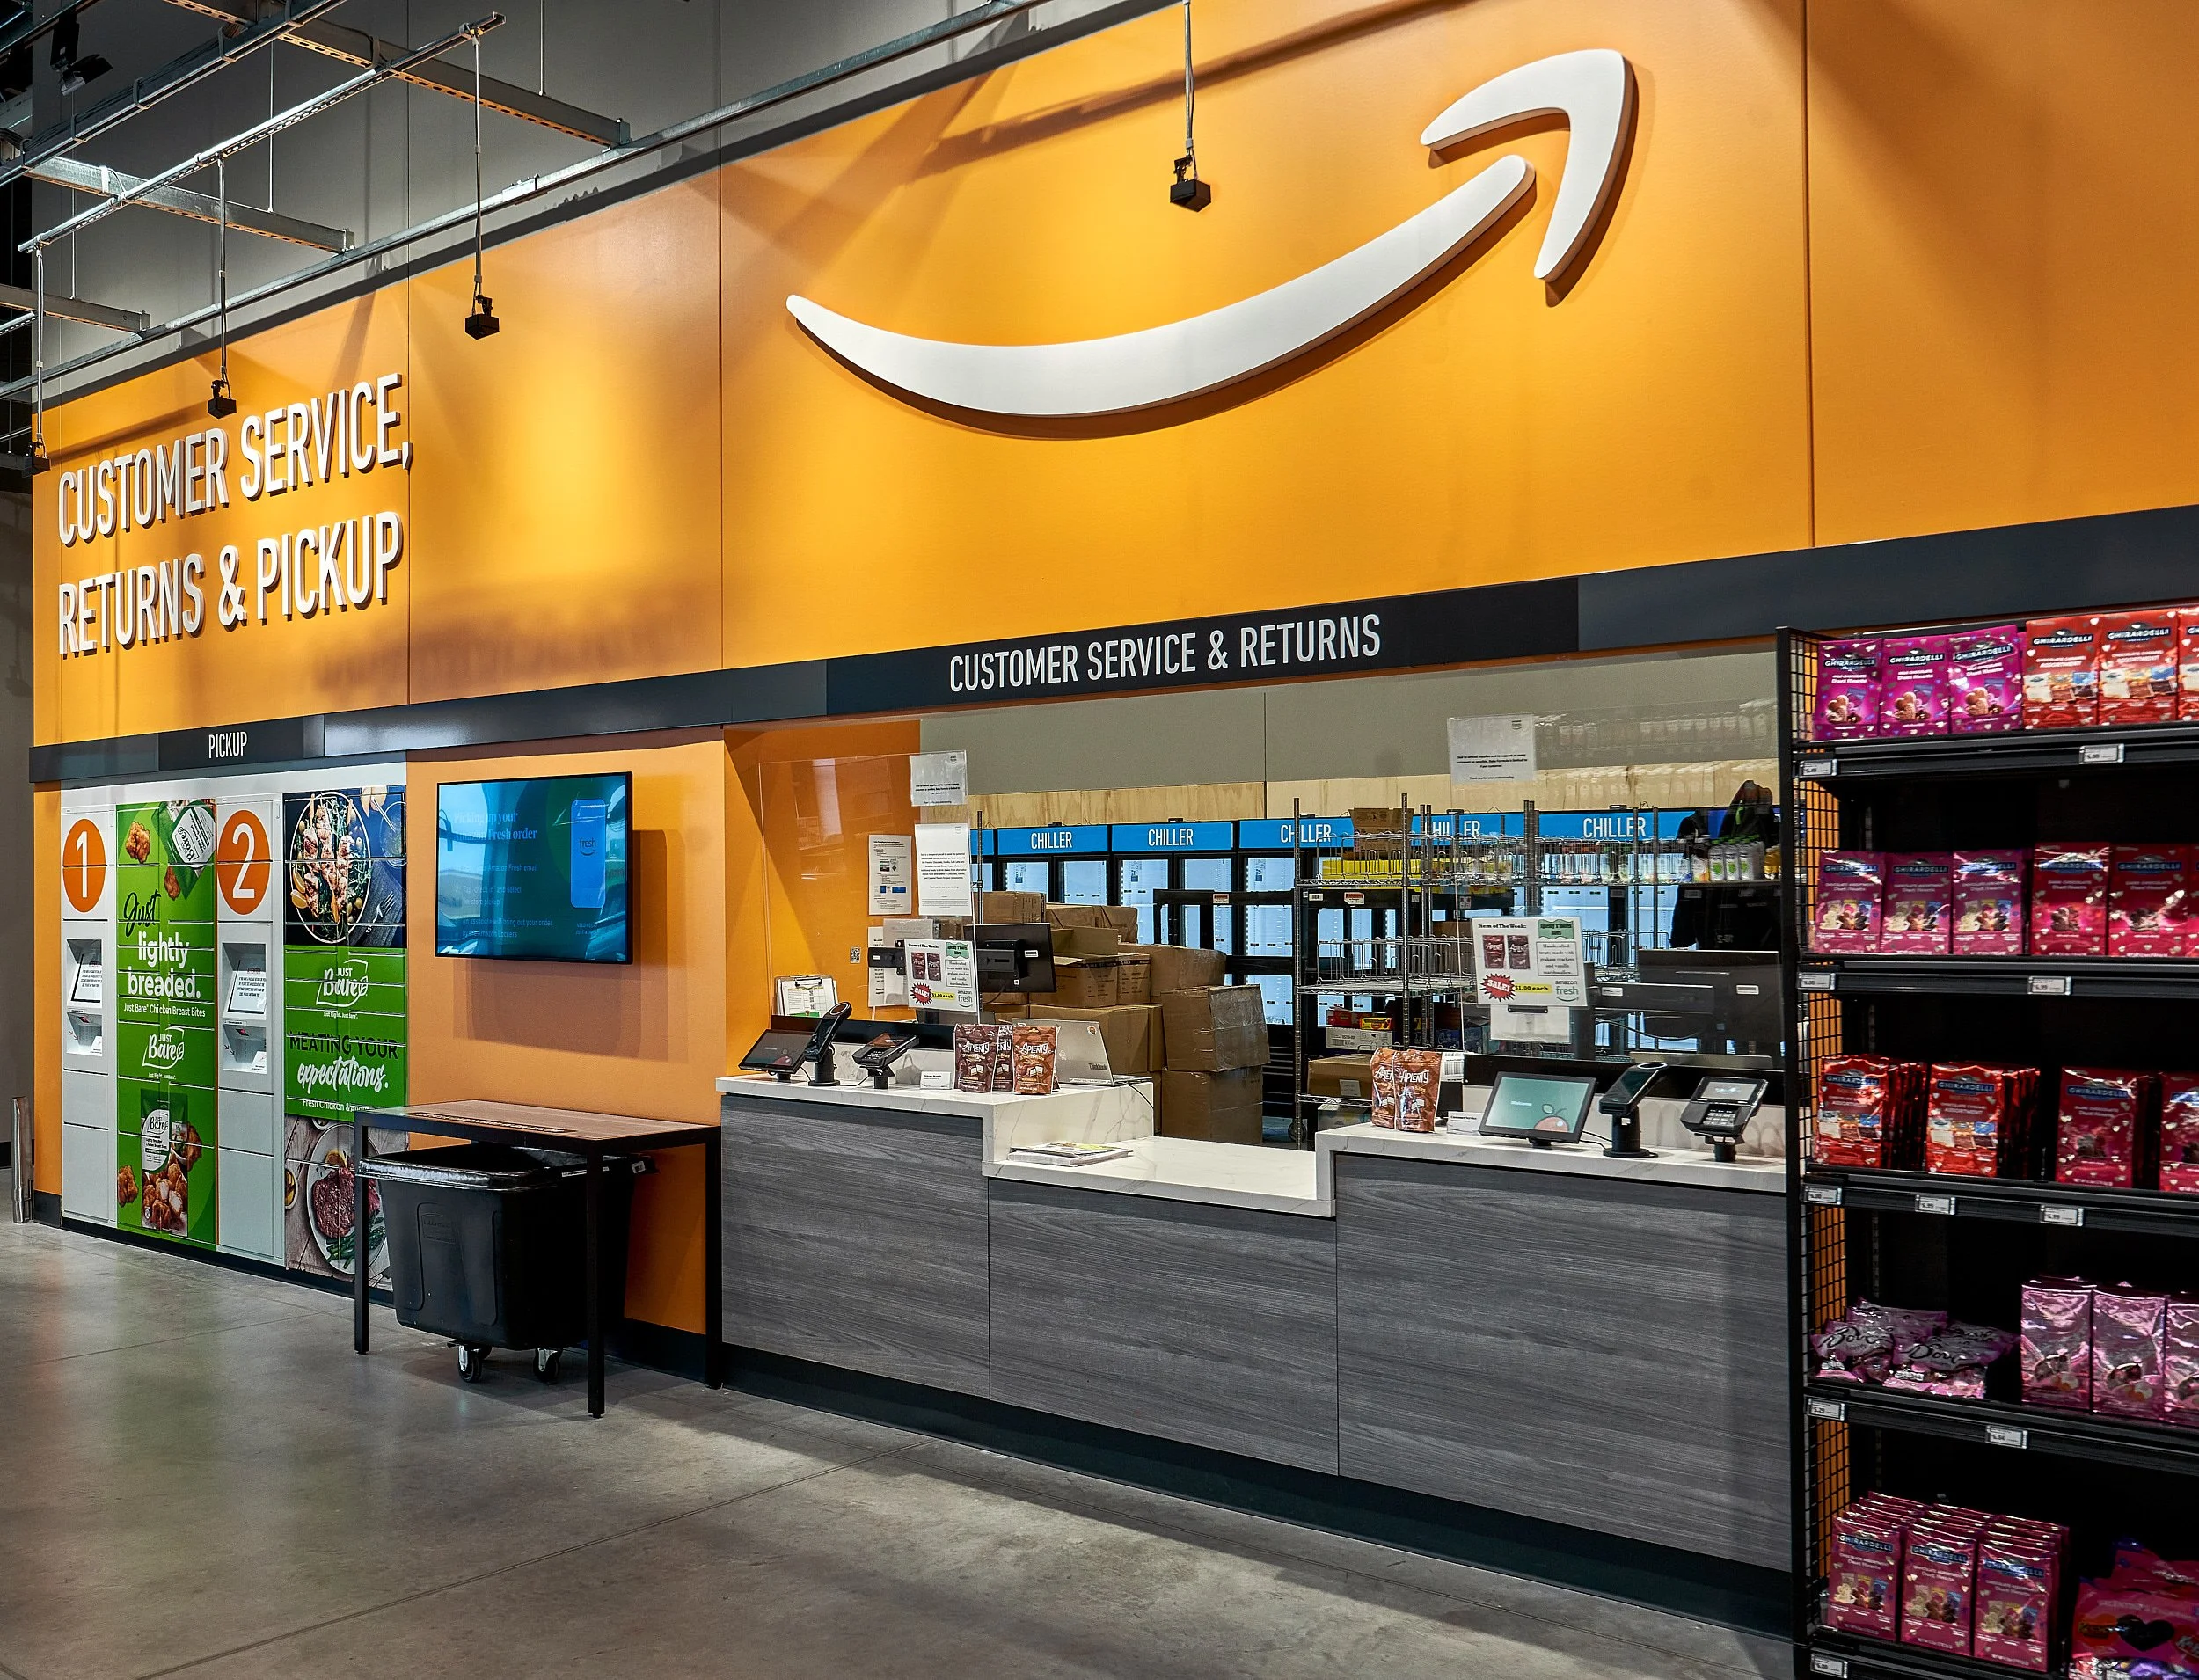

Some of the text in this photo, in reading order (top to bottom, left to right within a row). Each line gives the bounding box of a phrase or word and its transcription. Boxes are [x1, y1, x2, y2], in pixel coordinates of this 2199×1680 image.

[58, 373, 413, 546] CUSTOMER SERVICE,
[59, 511, 404, 659] RETURNS & PICKUP
[2033, 635, 2093, 645] GHIRARDELLI
[2108, 628, 2169, 639] GHIRARDELLI
[950, 613, 1381, 692] CUSTOMER SERVICE & RETURNS
[1890, 654, 1943, 663] GHIRARDELLI
[1955, 646, 2012, 659] GHIRARDELLI
[1825, 658, 1875, 668] GHIRARDELLI
[208, 731, 247, 759] PICKUP
[498, 811, 518, 826] your
[488, 829, 511, 840] Fresh
[513, 827, 538, 840] order
[1281, 823, 1332, 844] CHLLER
[1583, 816, 1646, 838] CHILLER
[580, 838, 596, 848] fresh
[1031, 831, 1073, 850] CHILLER
[1148, 828, 1194, 846] CHILLER
[77, 831, 88, 898] 1
[232, 822, 255, 899] 2
[124, 889, 161, 937] Just
[138, 931, 190, 968] lightly
[336, 968, 353, 977] JUST
[128, 967, 201, 999] breaded.
[323, 968, 359, 997] Bare
[1487, 979, 1510, 992] SALE!
[1556, 986, 1579, 995] fresh
[124, 1003, 134, 1012] Just
[150, 1004, 172, 1014] Chicken
[172, 1006, 190, 1016] Breast
[192, 1007, 206, 1017] Bites
[158, 1034, 172, 1042] JUST
[289, 1030, 398, 1060] MEATING YOUR
[997, 1040, 1011, 1051] ENTY
[148, 1034, 177, 1060] Bare
[961, 1041, 990, 1054] APLENTY
[1020, 1042, 1050, 1055] APLENTY
[297, 1055, 389, 1094] expectations.
[1400, 1070, 1429, 1083] APLENTY
[1938, 1081, 1994, 1092] GHIRARDELLI
[303, 1099, 318, 1107] Fresh
[319, 1100, 345, 1112] Chicken
[1839, 1535, 1894, 1552] GHIRARDELLI
[1912, 1545, 1968, 1563] GHIRARDELLI
